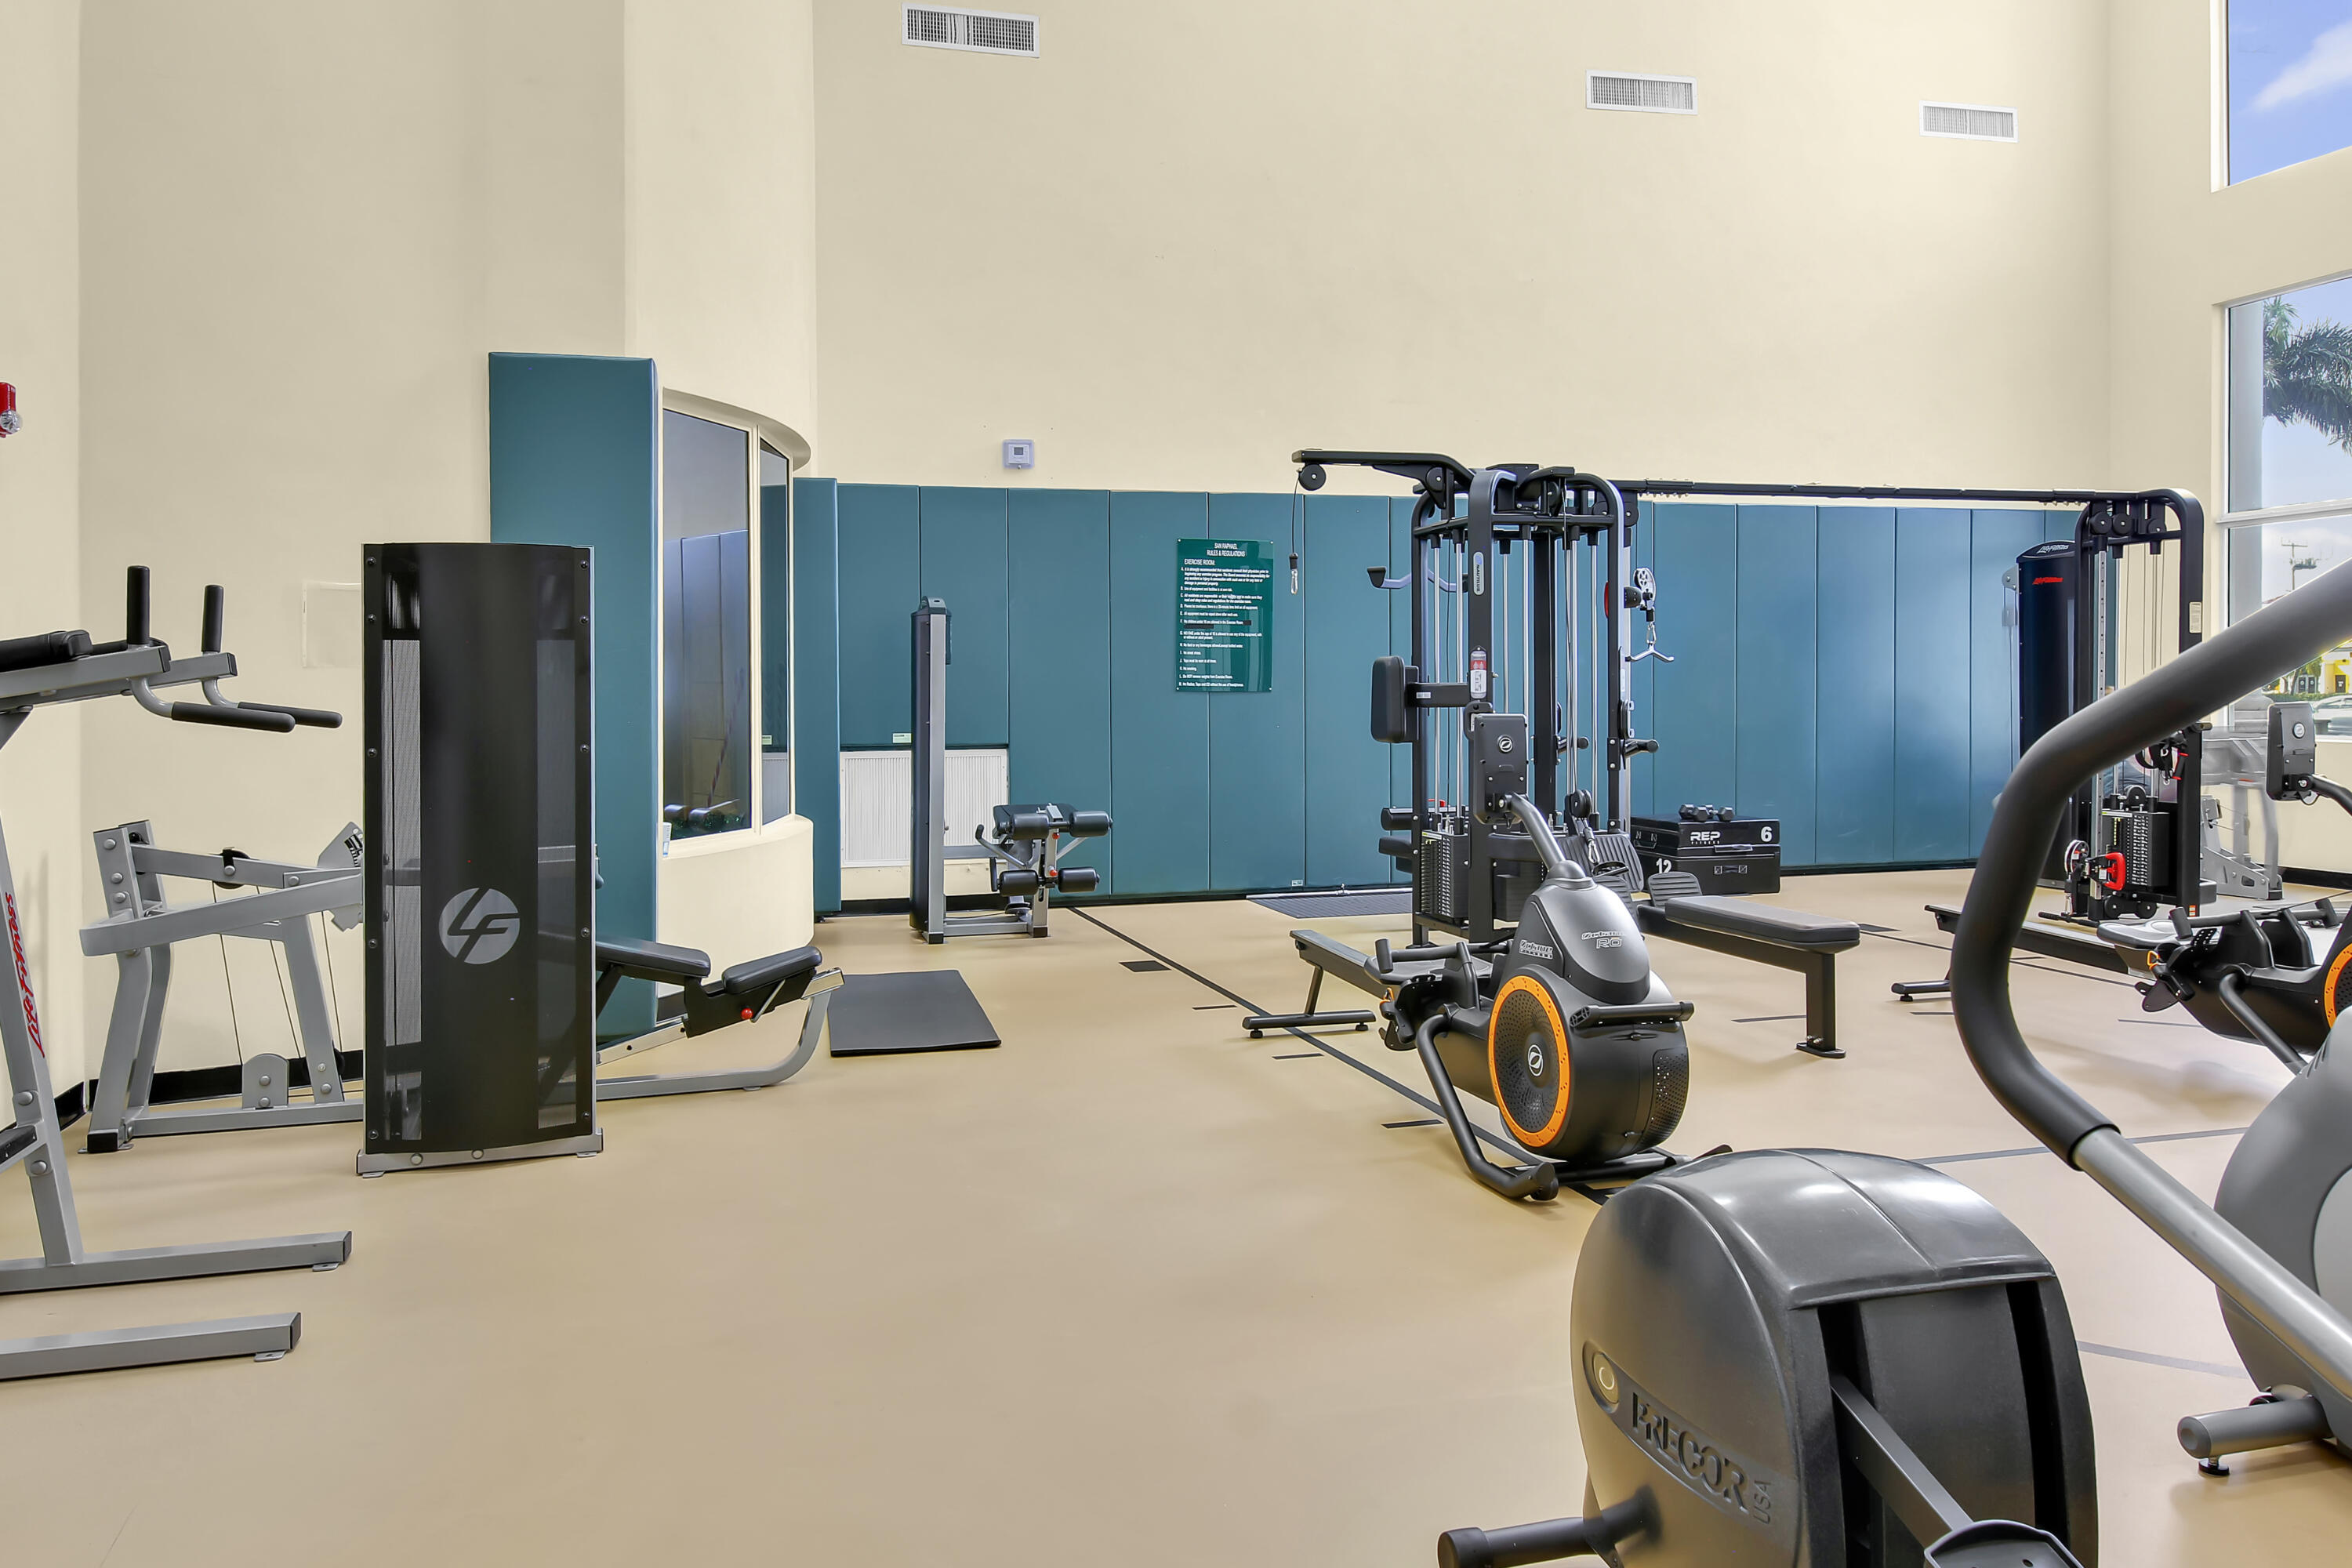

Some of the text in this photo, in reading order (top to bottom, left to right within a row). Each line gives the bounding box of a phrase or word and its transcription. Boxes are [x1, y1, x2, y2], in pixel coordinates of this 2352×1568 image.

[1690, 831, 1721, 841] REP
[1760, 826, 1773, 843] 6
[1656, 858, 1672, 874] 12
[1632, 1392, 1750, 1515] PRECOR
[1753, 1479, 1772, 1525] USA
